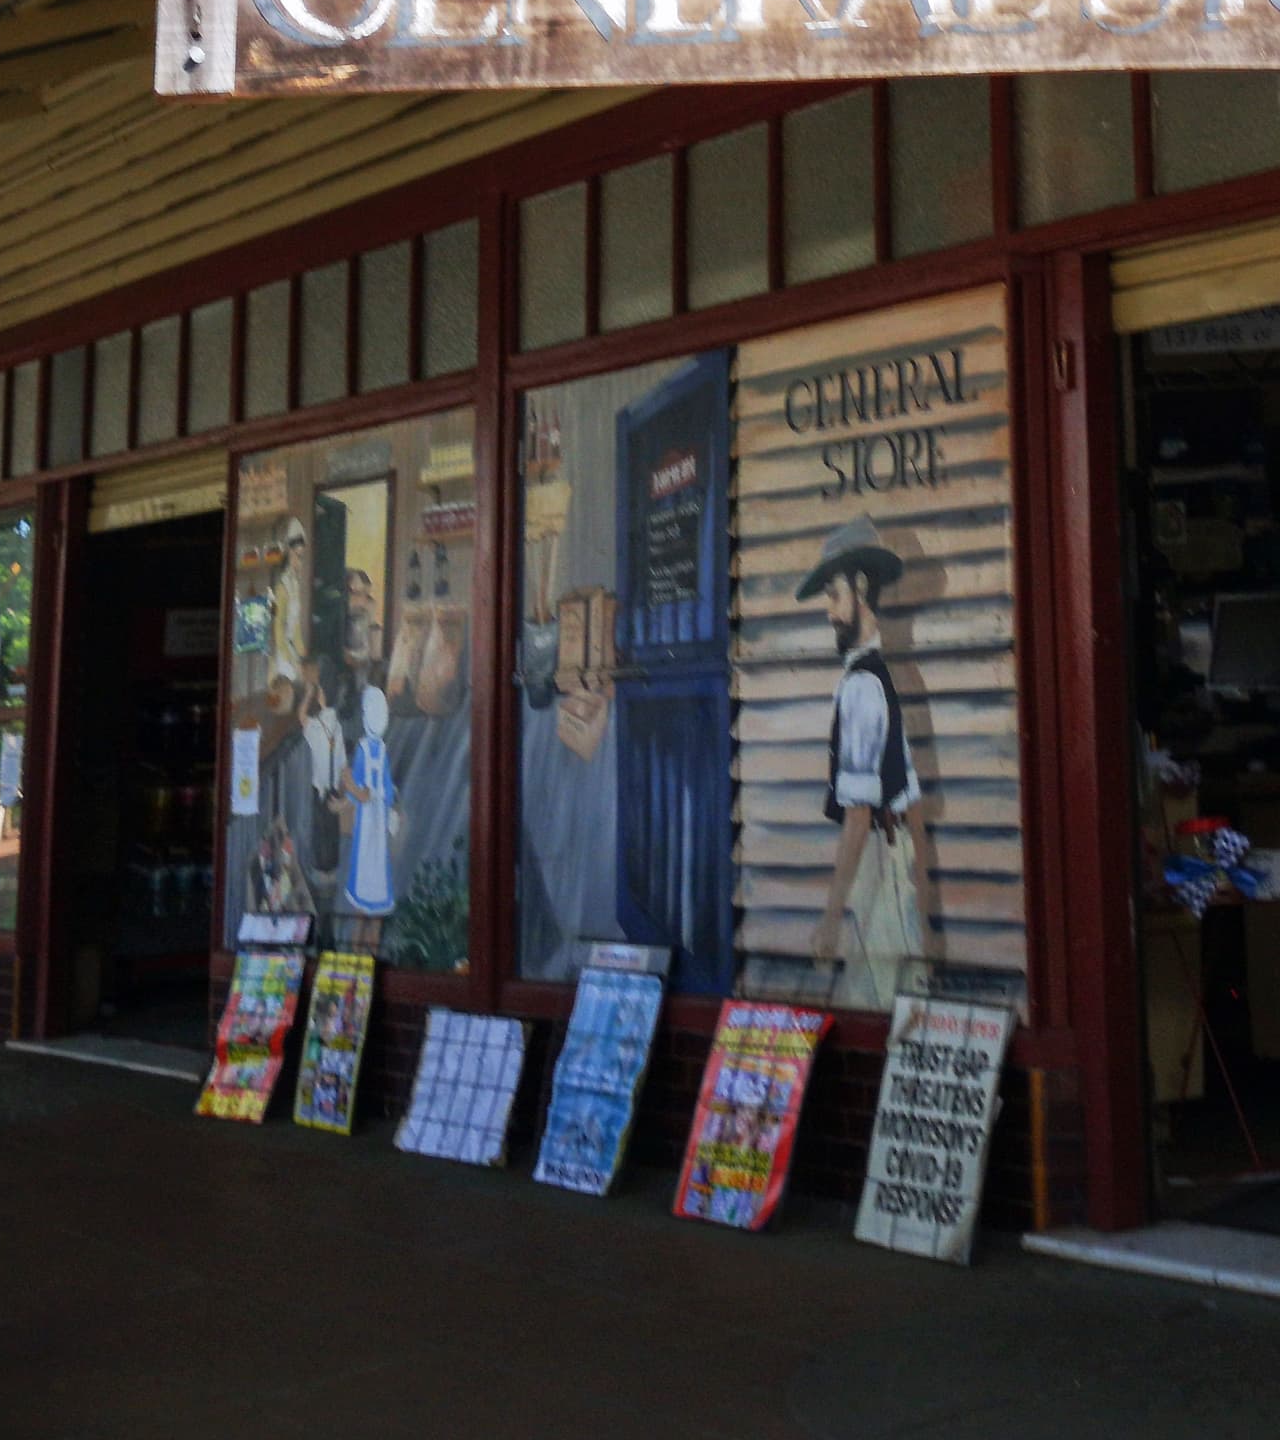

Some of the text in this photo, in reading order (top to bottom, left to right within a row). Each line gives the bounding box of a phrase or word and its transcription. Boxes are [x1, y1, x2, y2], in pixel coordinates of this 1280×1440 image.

[785, 348, 979, 434] GENERAL
[822, 426, 948, 498] STORE
[899, 1039, 991, 1082] TRUST GAP
[891, 1072, 987, 1121] THREATENS
[875, 1179, 967, 1229] RESPONSE
